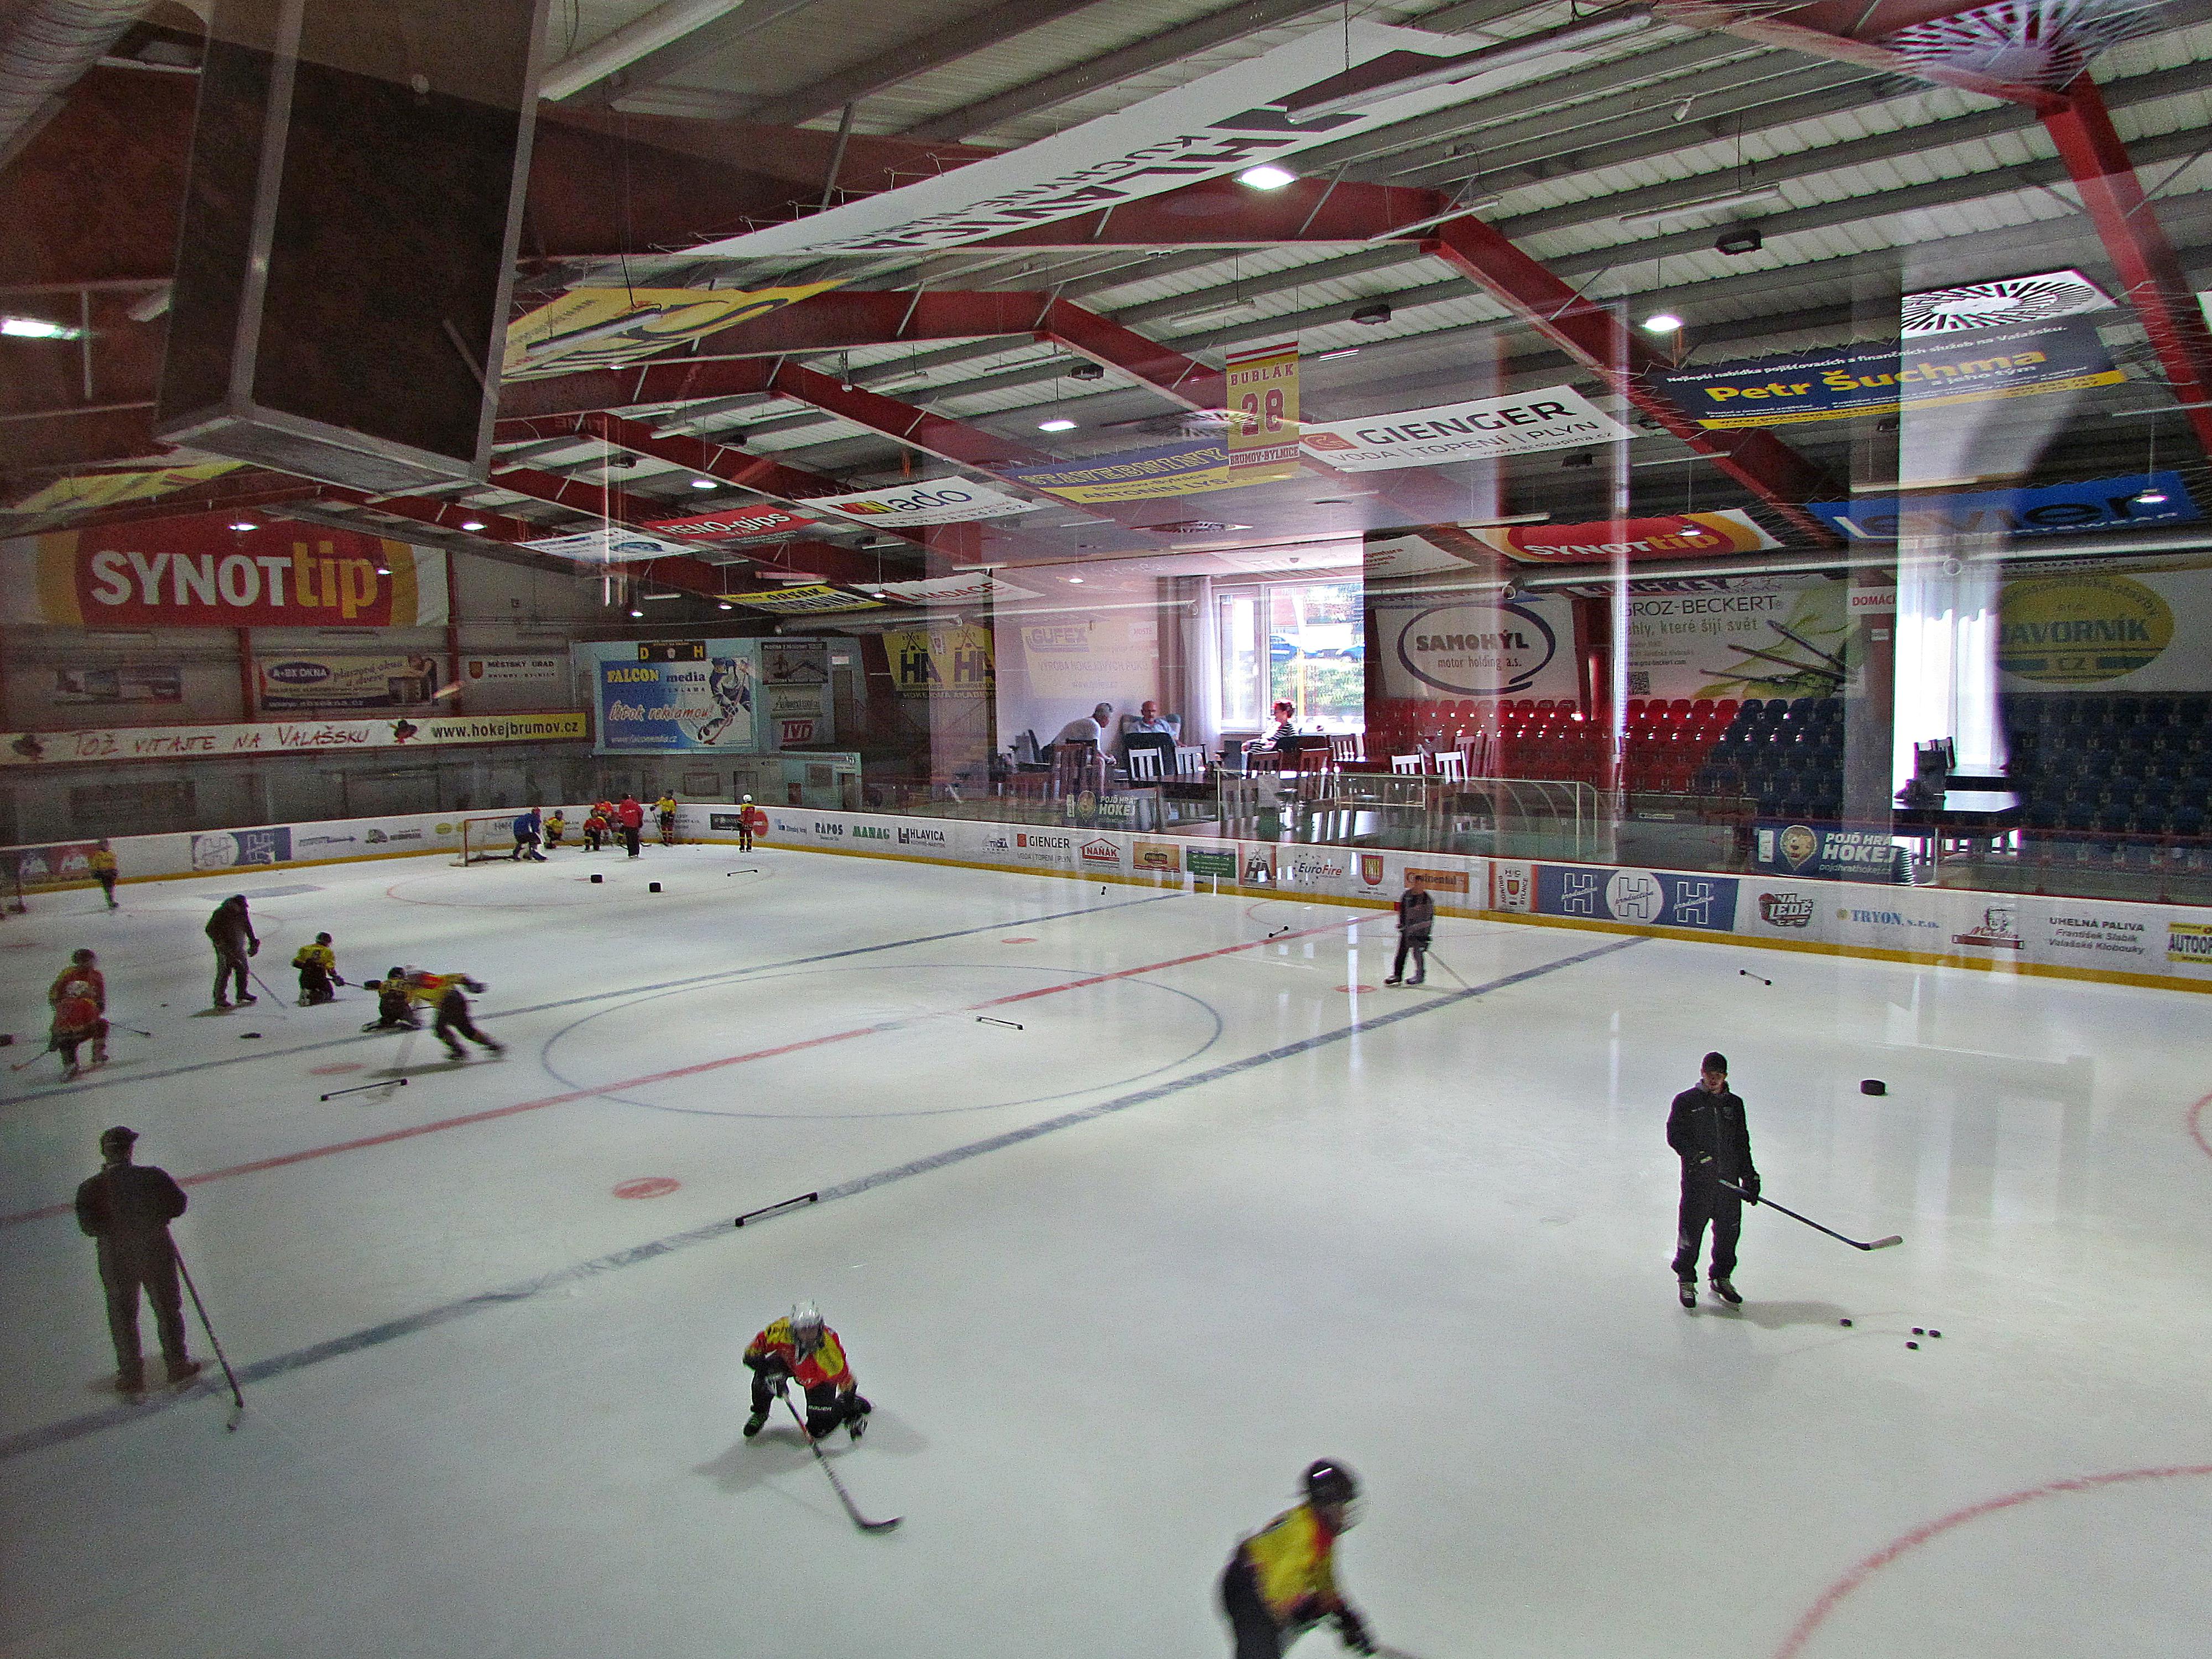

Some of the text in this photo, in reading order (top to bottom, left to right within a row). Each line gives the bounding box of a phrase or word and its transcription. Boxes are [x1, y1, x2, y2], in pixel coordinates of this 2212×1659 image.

[842, 136, 1300, 251] HLAVICA
[1230, 363, 1294, 386] BUBLÁK
[1704, 382, 1812, 402] Petr
[1820, 351, 2047, 392] Šuchma
[1994, 366, 2036, 376] tým
[1241, 388, 1285, 437] 28
[1356, 401, 1577, 444] GIENGER
[1328, 421, 1601, 462] VODA TOPENÍ PLYN
[1230, 446, 1300, 465] BRUMOV-BYLNICE
[1523, 531, 1721, 557] SYNOTtip
[91, 541, 379, 618] SYNOTtip
[1661, 619, 1696, 634] které
[1702, 617, 1722, 635] šijí
[1727, 618, 1758, 632] svět
[1031, 627, 1089, 644] GUFEX
[1417, 627, 1529, 651] SAMOHÝL
[640, 645, 704, 659] D H
[1438, 656, 1522, 671] motor holding a.s.
[607, 667, 706, 683] FALCON media
[431, 721, 579, 739] www.hokejbrumov.cz
[910, 829, 945, 842] HLAVICA
[1029, 836, 1070, 848] GIENGER
[1826, 832, 1892, 846] POJĎ HRÁ
[1823, 844, 1898, 863] HOKEJ
[1298, 862, 1343, 877] EuroFire
[2049, 916, 2145, 932] UHELNÁ PALIVA
[2095, 942, 2146, 955] Klobouky
